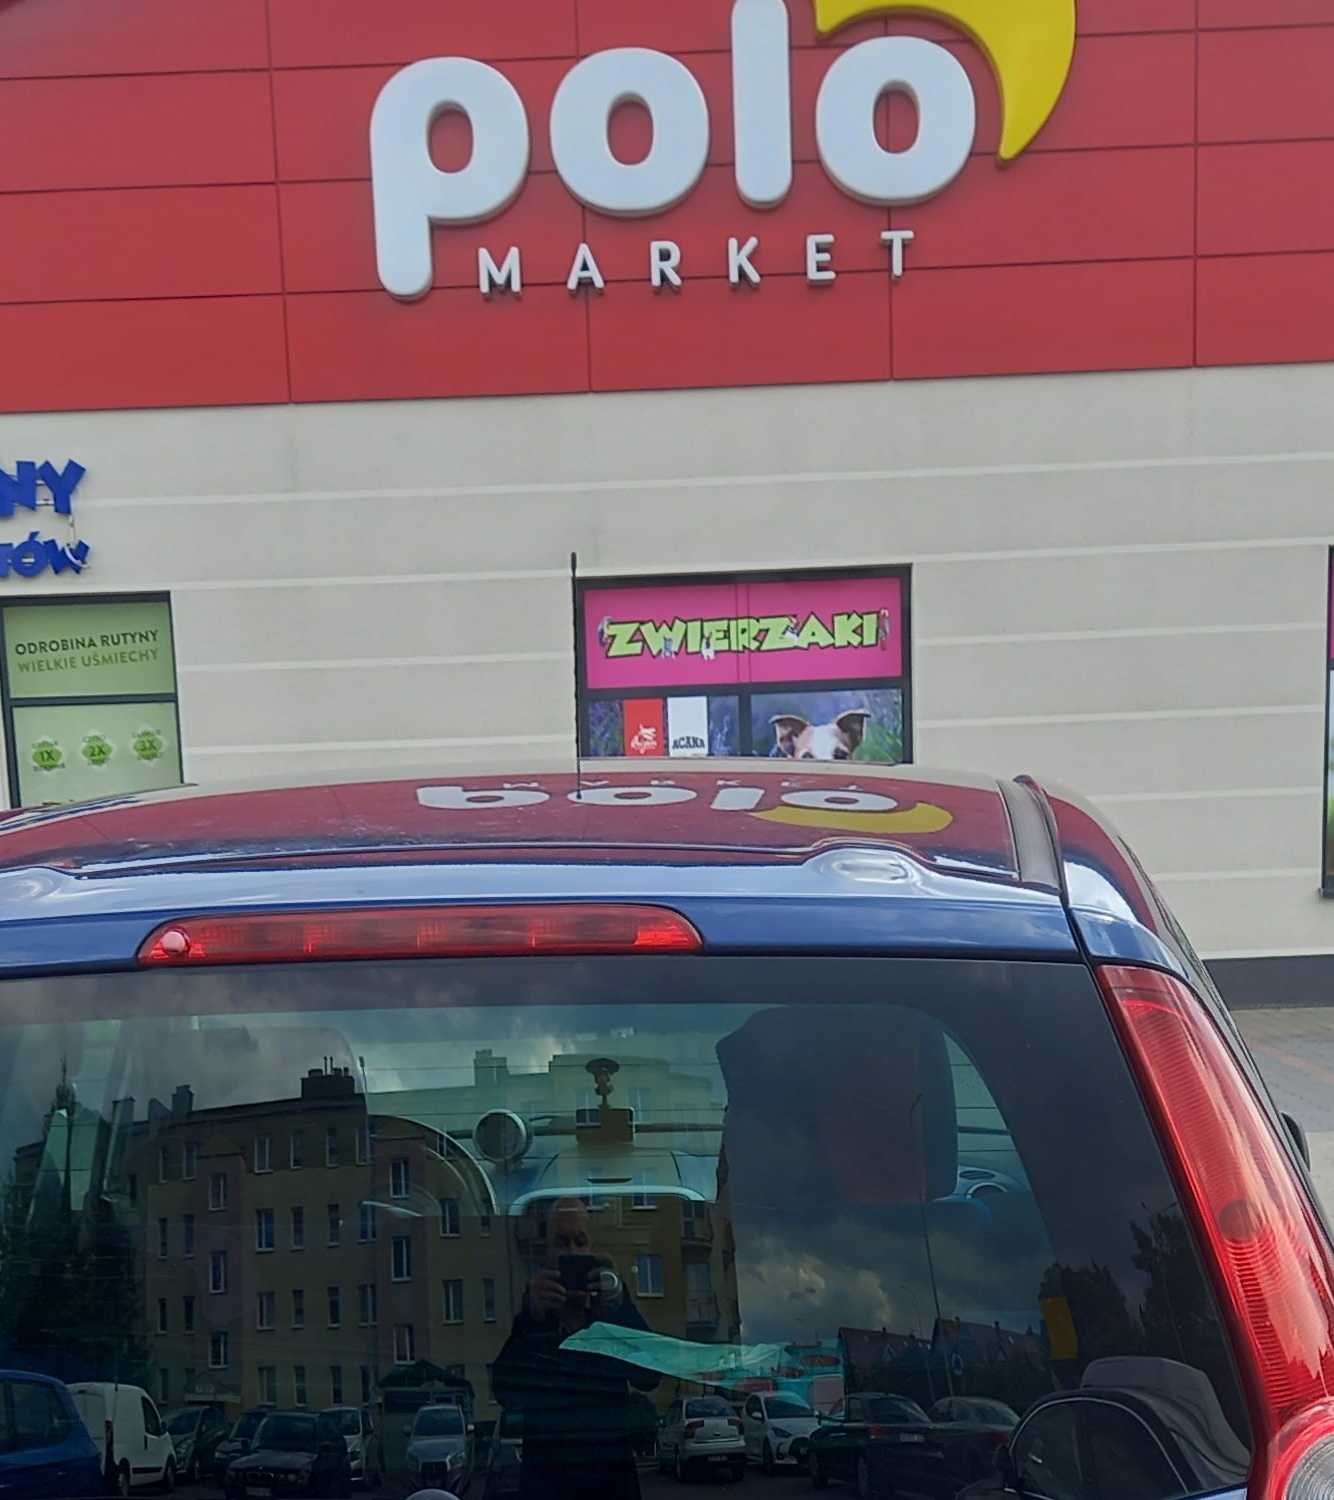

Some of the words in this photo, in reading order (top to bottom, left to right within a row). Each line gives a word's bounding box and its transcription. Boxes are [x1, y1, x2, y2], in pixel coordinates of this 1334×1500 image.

[370, 0, 976, 302] polo
[478, 230, 914, 299] MARKET
[15, 637, 97, 655] ODROBINA
[100, 629, 159, 647] RUTYNY
[605, 610, 880, 659] ZWIERZAKI
[18, 656, 77, 673] WIELKIE
[82, 649, 159, 667] UŚMIECHY
[672, 736, 705, 749] ACANA
